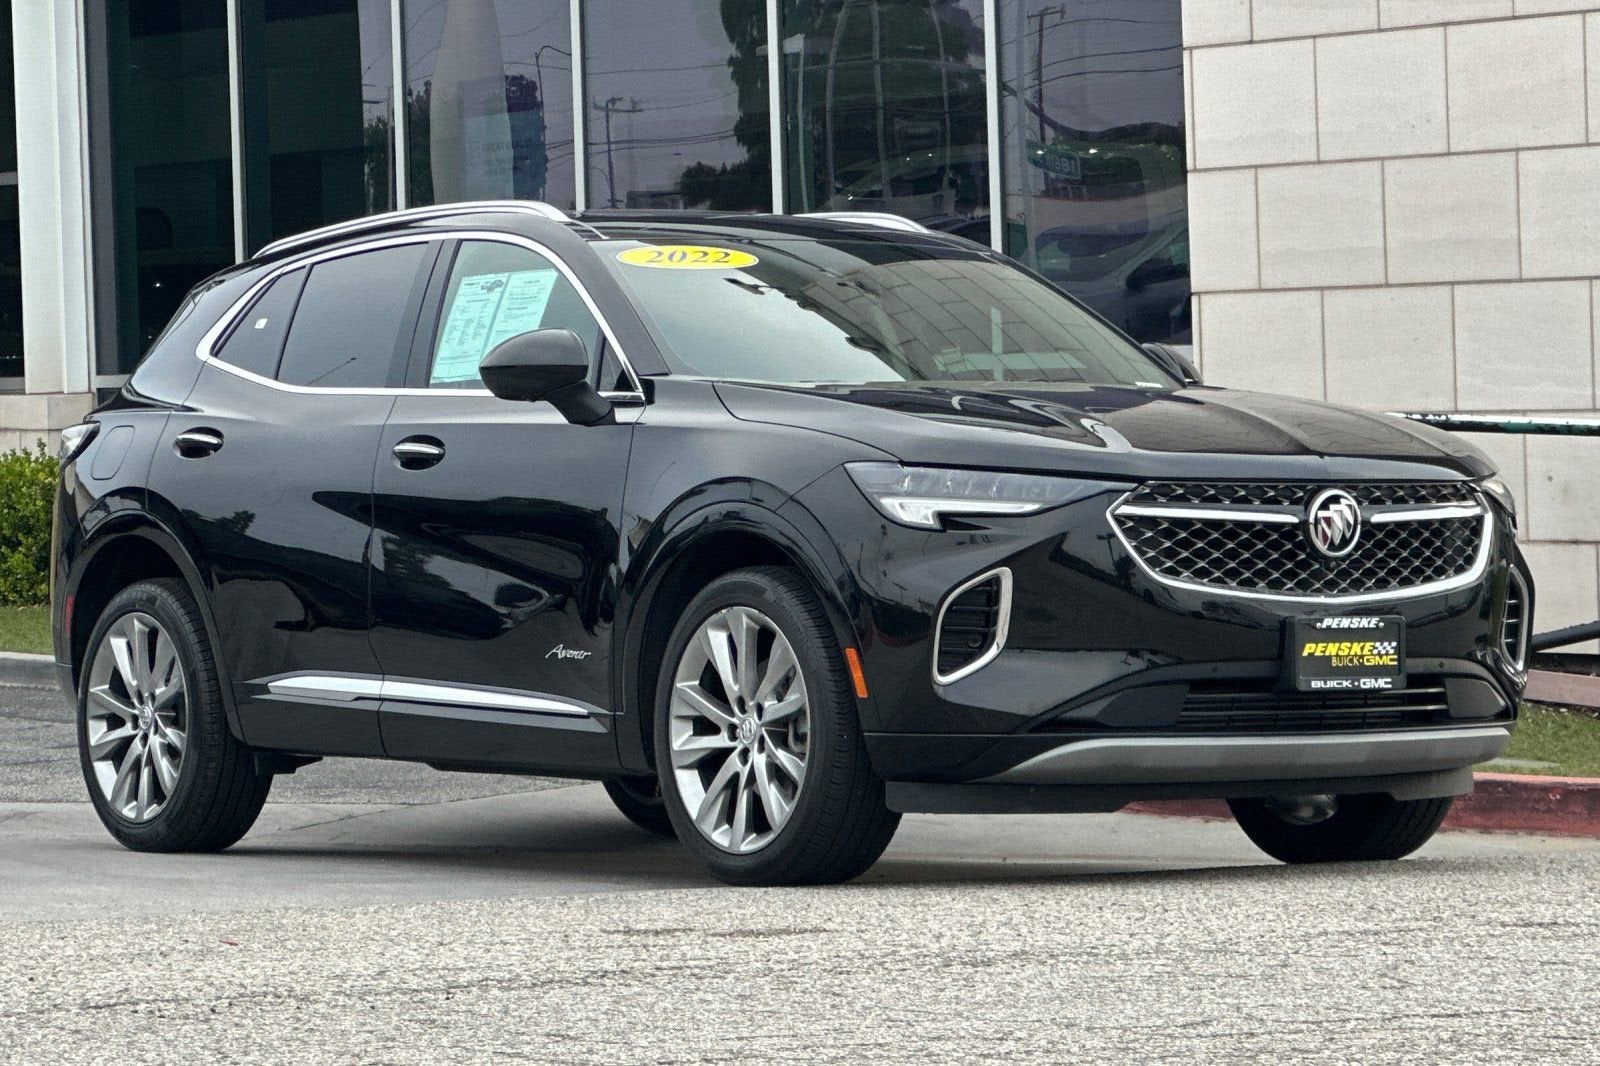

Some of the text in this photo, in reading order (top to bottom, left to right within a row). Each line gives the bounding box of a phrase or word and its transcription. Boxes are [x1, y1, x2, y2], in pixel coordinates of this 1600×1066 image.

[646, 250, 731, 264] 2022
[1321, 617, 1380, 628] PENSKE
[1302, 642, 1375, 656] PENSKE
[1331, 655, 1398, 667] BUICK GMC
[1311, 678, 1392, 689] BUICK GMC
